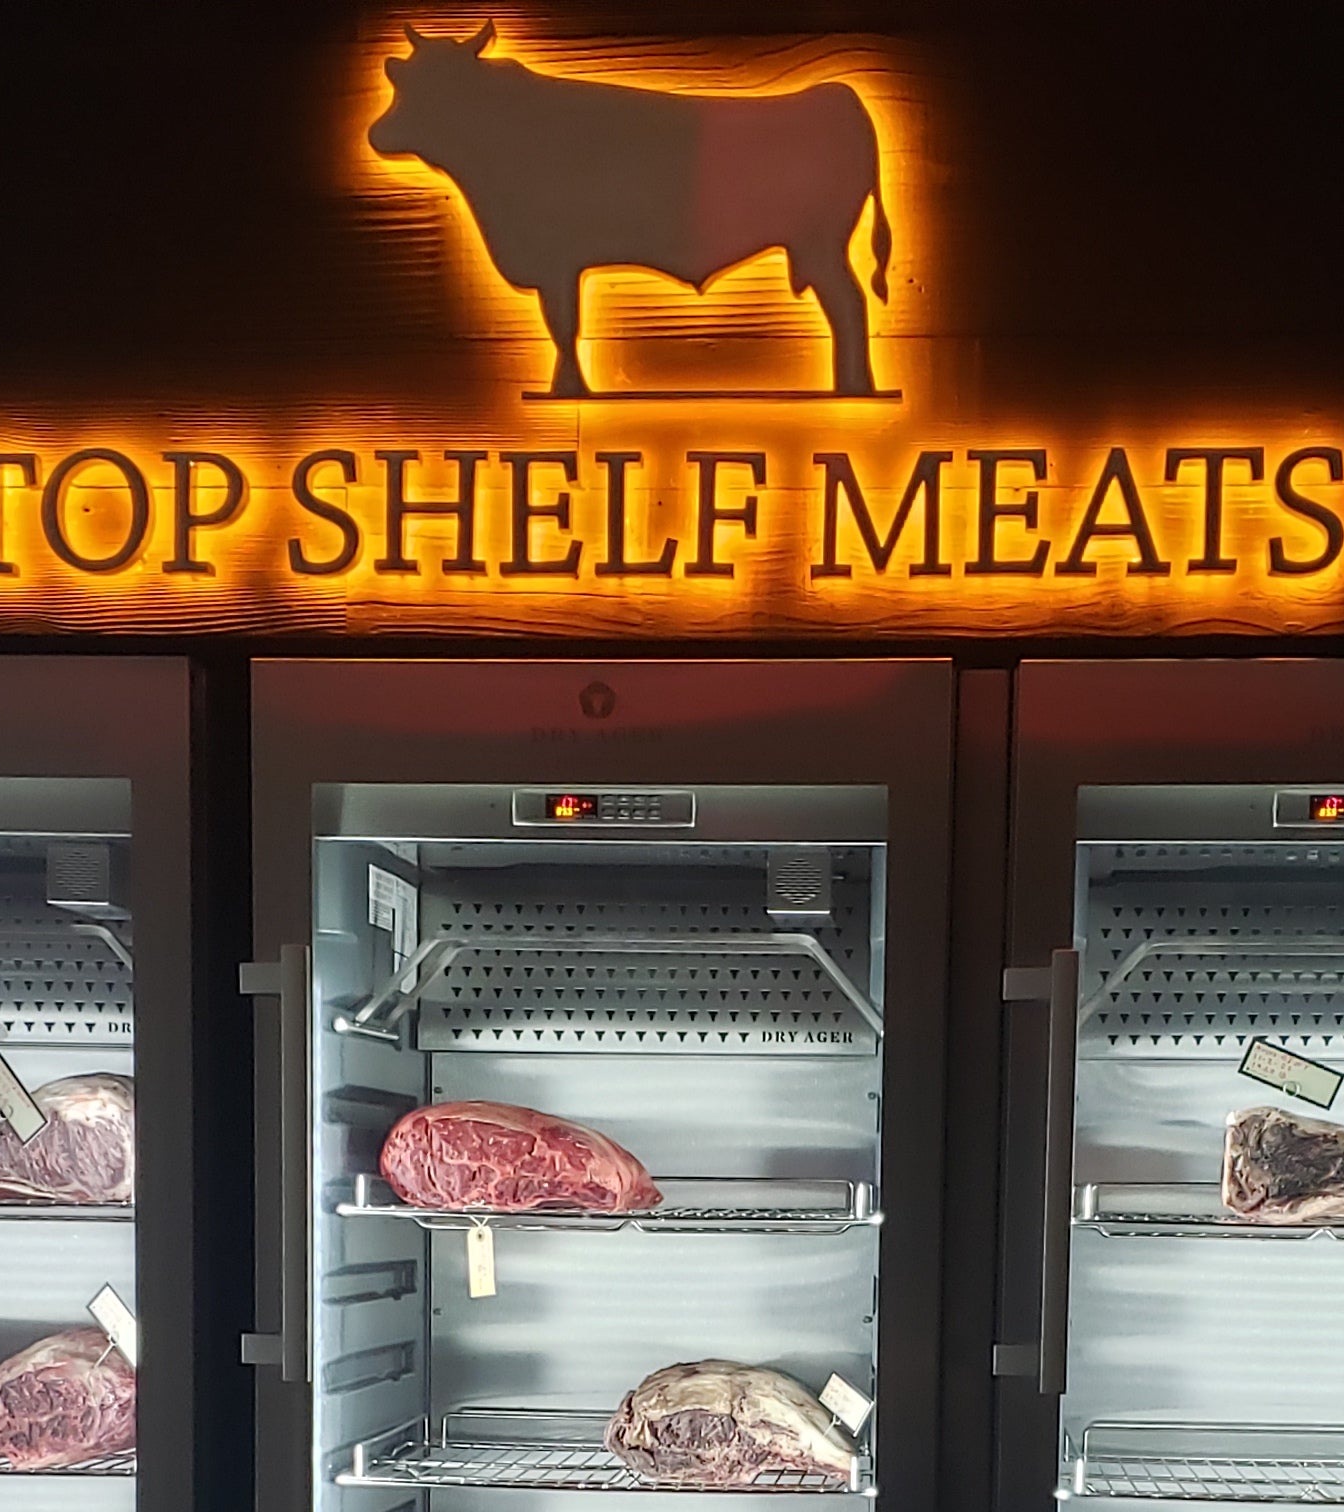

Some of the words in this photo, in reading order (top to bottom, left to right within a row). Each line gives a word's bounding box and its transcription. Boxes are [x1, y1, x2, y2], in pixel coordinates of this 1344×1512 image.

[287, 446, 766, 577] SHELF
[811, 446, 1344, 577] MEATS
[761, 1030, 798, 1043] DRY
[803, 1030, 854, 1044] AGER
